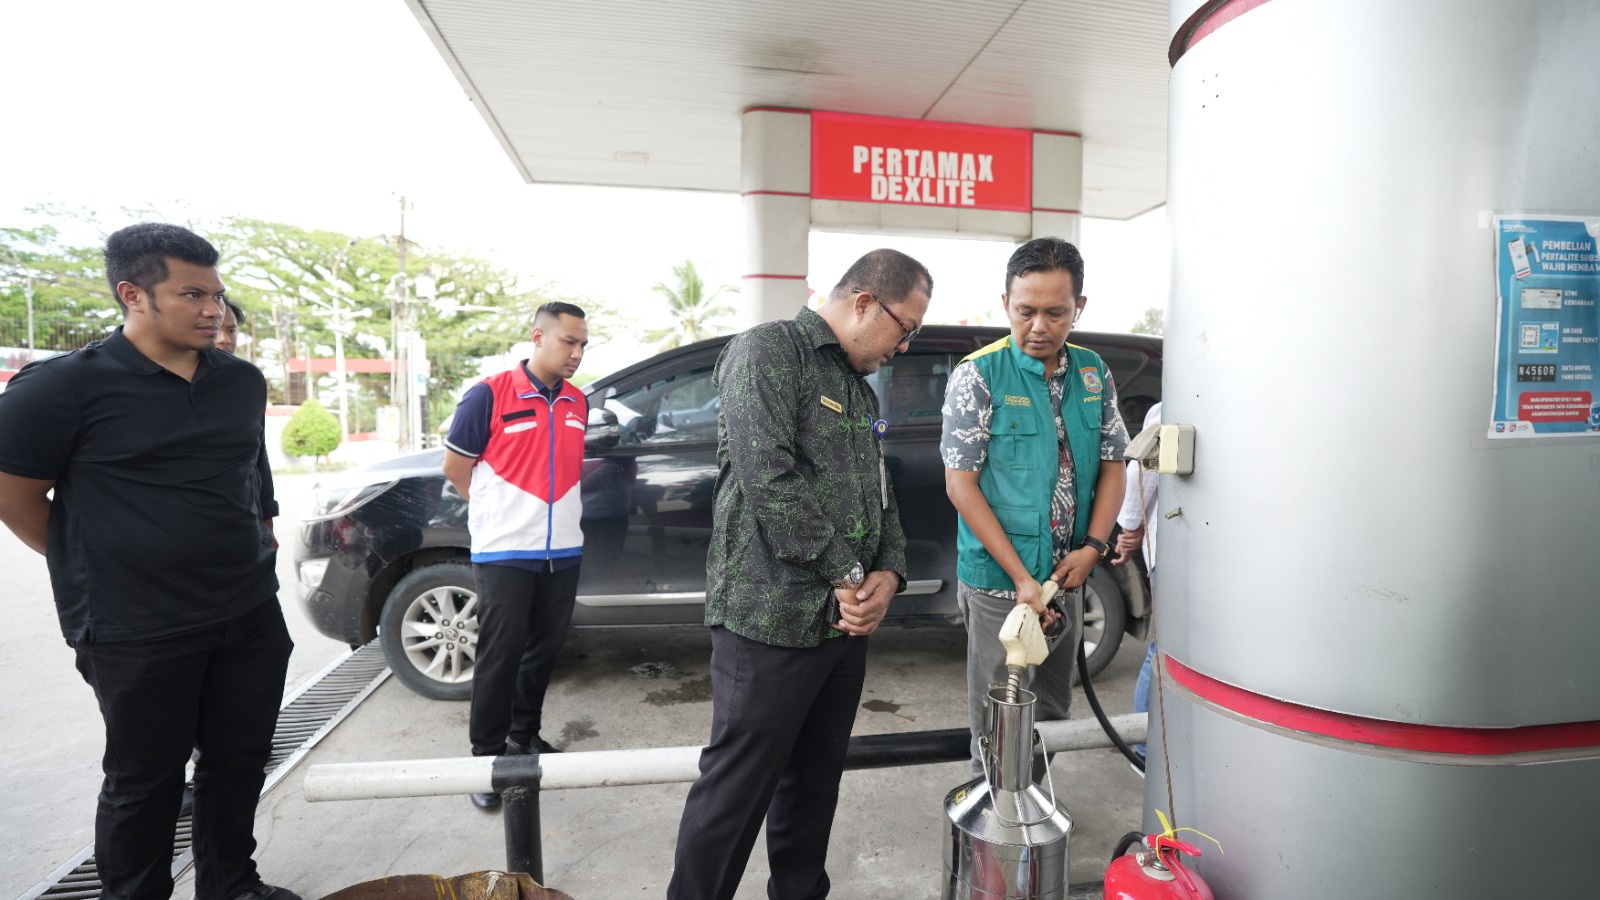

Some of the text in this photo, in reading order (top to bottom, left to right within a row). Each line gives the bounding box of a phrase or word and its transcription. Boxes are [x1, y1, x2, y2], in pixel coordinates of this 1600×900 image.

[853, 145, 994, 182] PERTAMAX
[871, 174, 976, 206] DEXLITE
[1542, 240, 1591, 251] PEMBELIAN
[1541, 252, 1579, 261] PERTALITE
[1541, 262, 1566, 271] WAJIB
